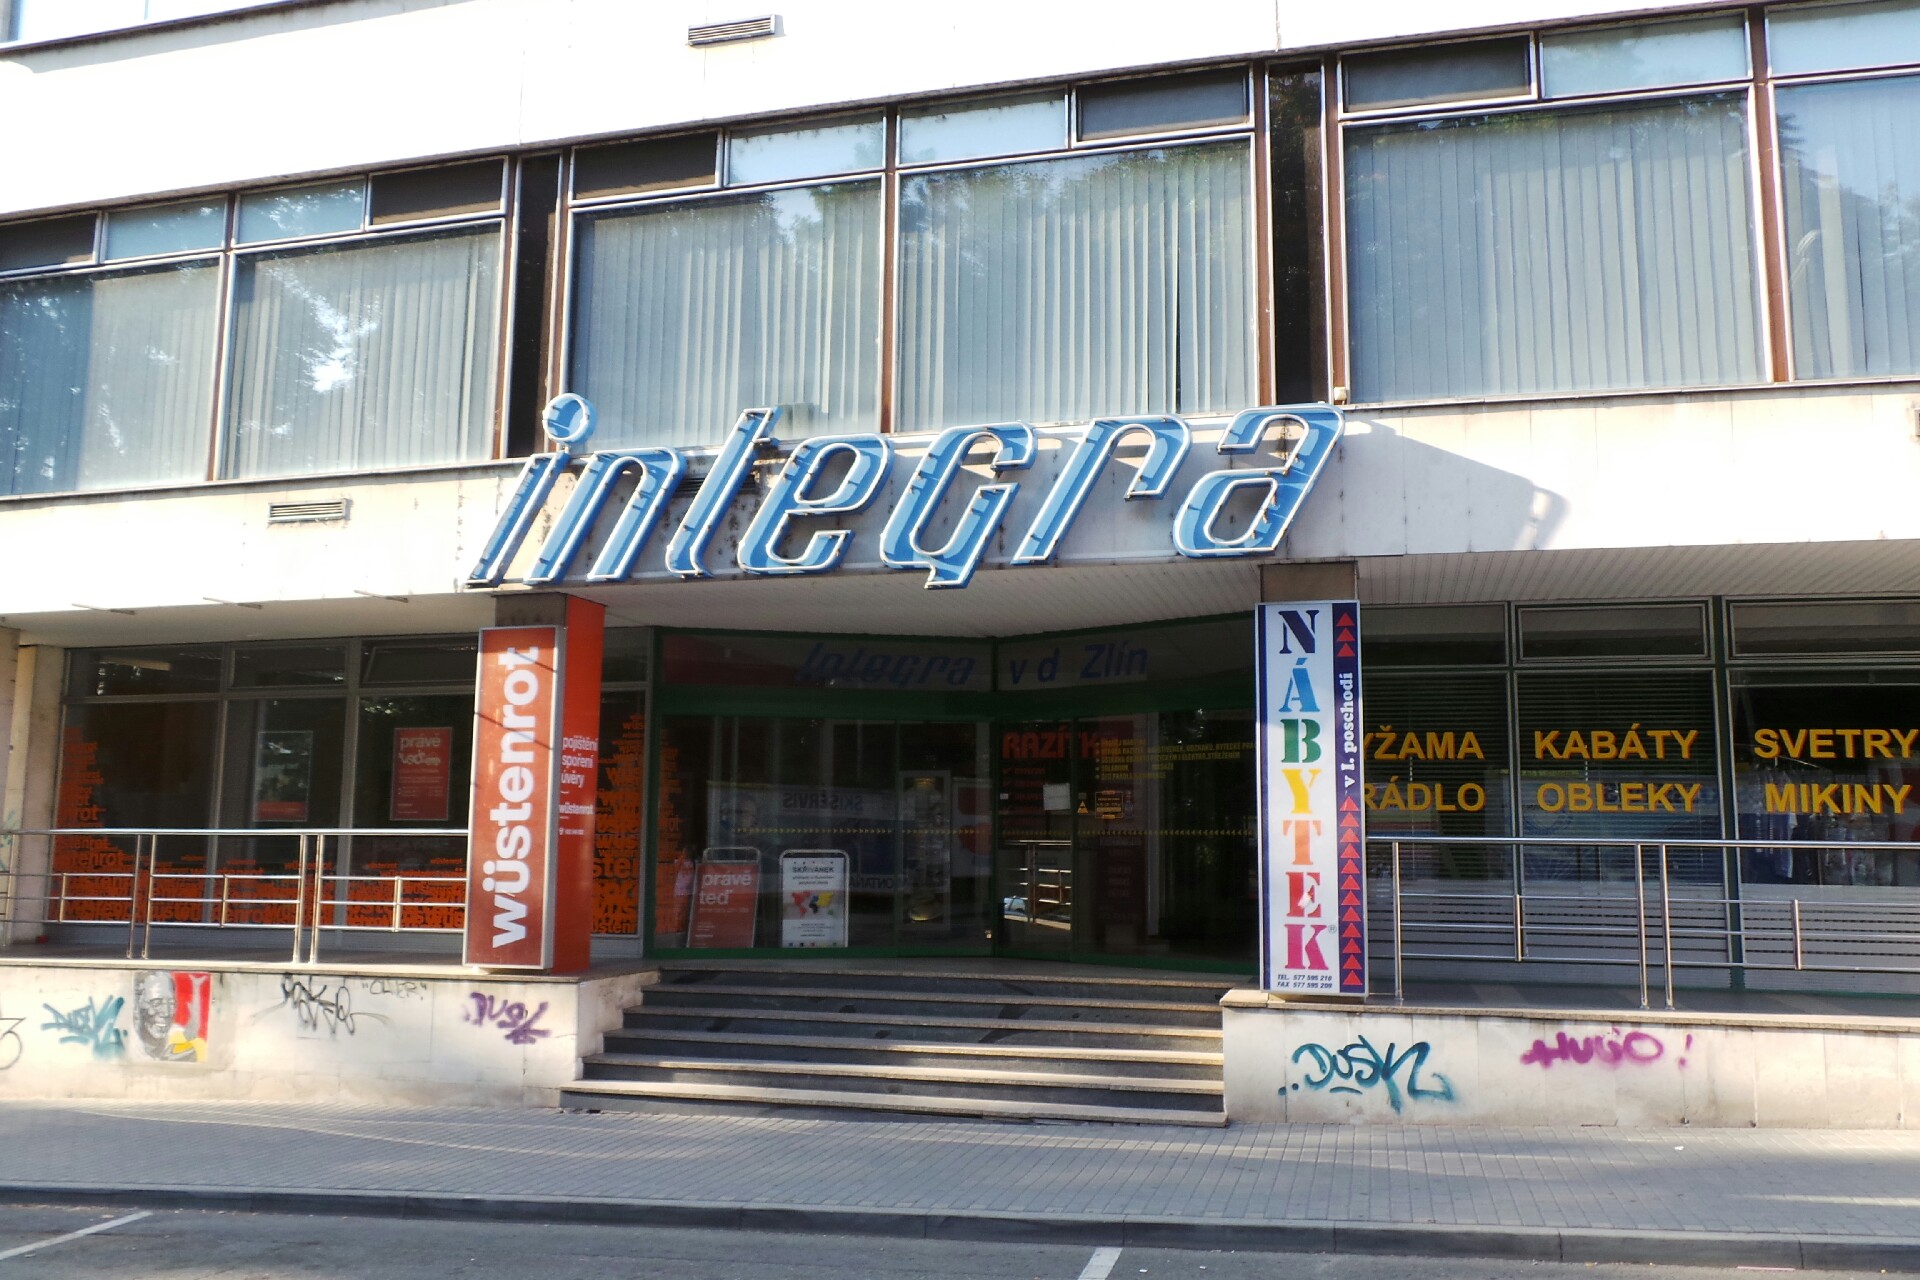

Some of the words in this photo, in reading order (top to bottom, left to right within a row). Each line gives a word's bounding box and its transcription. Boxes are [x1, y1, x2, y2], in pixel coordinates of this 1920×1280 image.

[1037, 647, 1060, 683] d
[1339, 672, 1358, 753] poschodí
[1535, 723, 1697, 759] KABÁTY
[1754, 728, 1919, 759] SVETRY
[482, 646, 539, 949] wüstenrot
[1278, 609, 1330, 971] NÁBYTEK
[1343, 775, 1356, 788] v
[1537, 782, 1700, 814] OBLEKY
[1765, 783, 1911, 815] MIKINY
